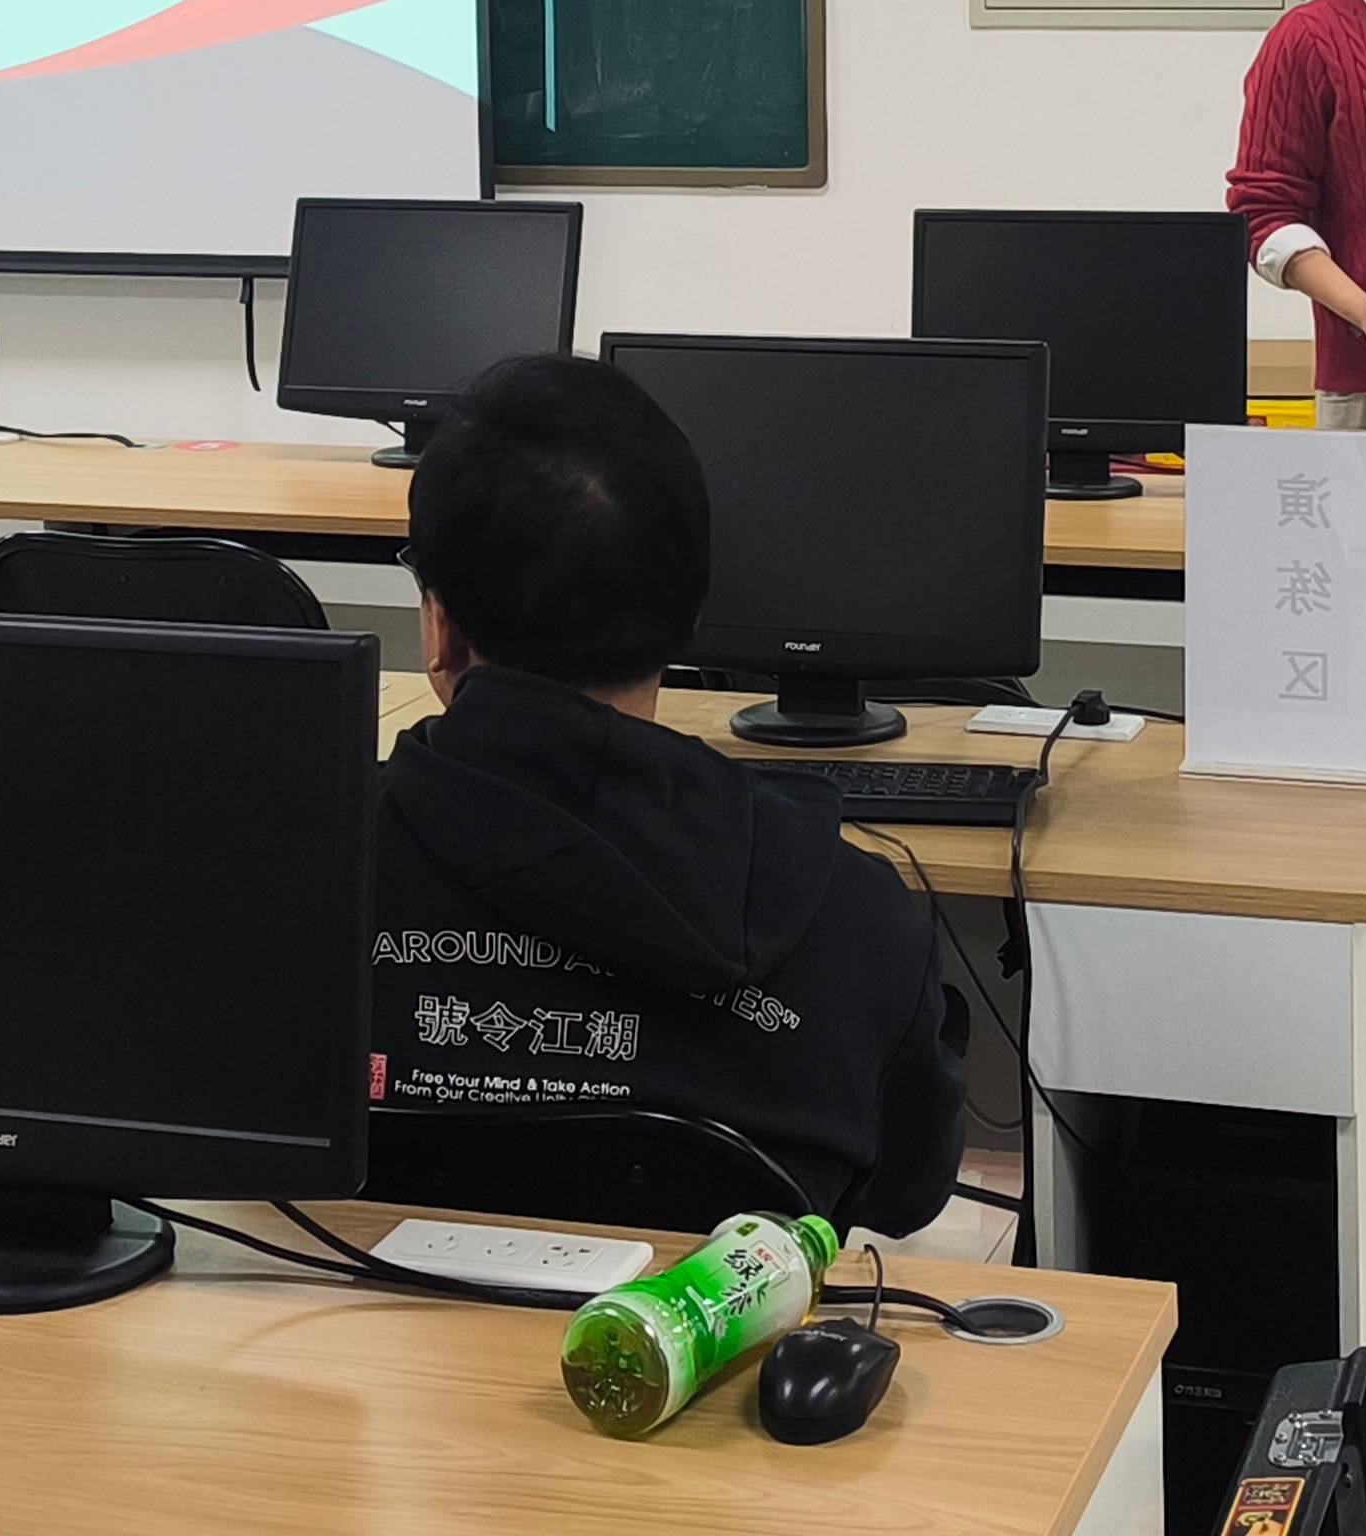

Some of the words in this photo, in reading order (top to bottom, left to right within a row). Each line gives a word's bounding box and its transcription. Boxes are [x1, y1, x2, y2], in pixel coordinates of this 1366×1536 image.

[372, 930, 562, 969] AROUND
[414, 994, 641, 1062] 號令江湖
[395, 1080, 432, 1097] From
[436, 1086, 463, 1103] Our
[468, 1089, 531, 1103] Creative
[412, 1068, 444, 1085] Free
[447, 1073, 480, 1089] Your
[484, 1076, 521, 1091] Mind
[526, 1078, 537, 1091] &
[542, 1079, 576, 1093] Take
[580, 1081, 631, 1096] Action
